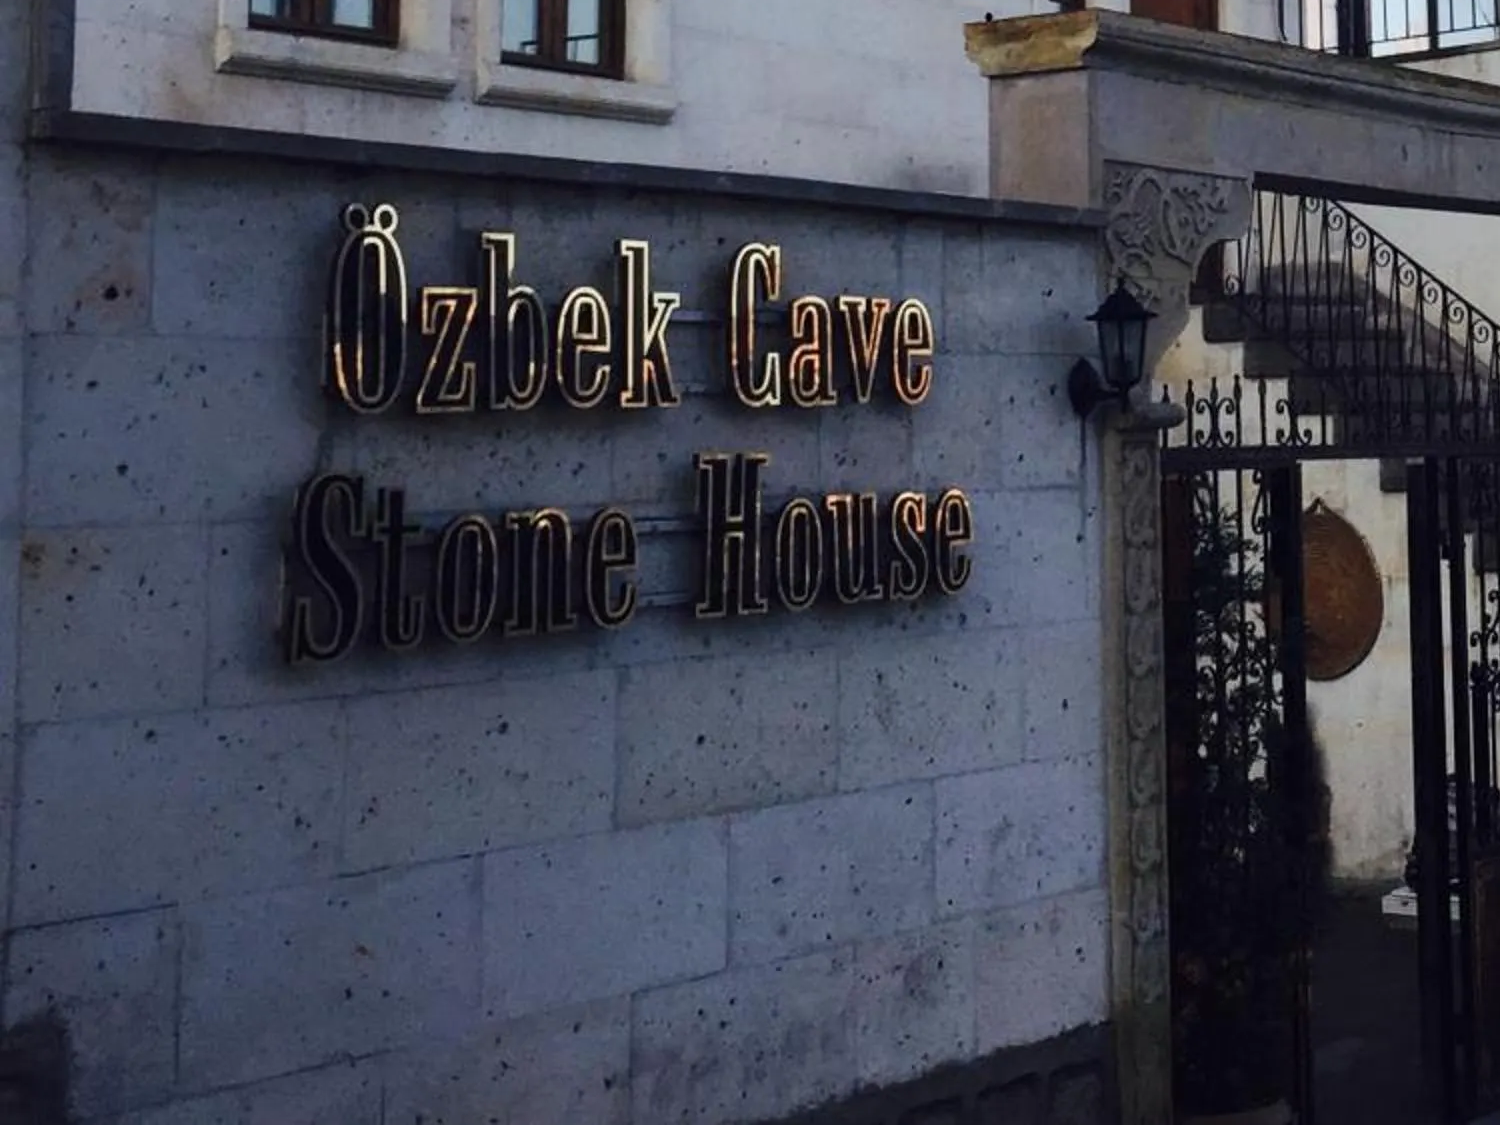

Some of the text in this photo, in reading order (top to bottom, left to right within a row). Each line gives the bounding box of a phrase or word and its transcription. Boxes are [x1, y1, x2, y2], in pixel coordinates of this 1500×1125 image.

[333, 203, 934, 414] Özbek Cave
[288, 452, 974, 666] Stone House
